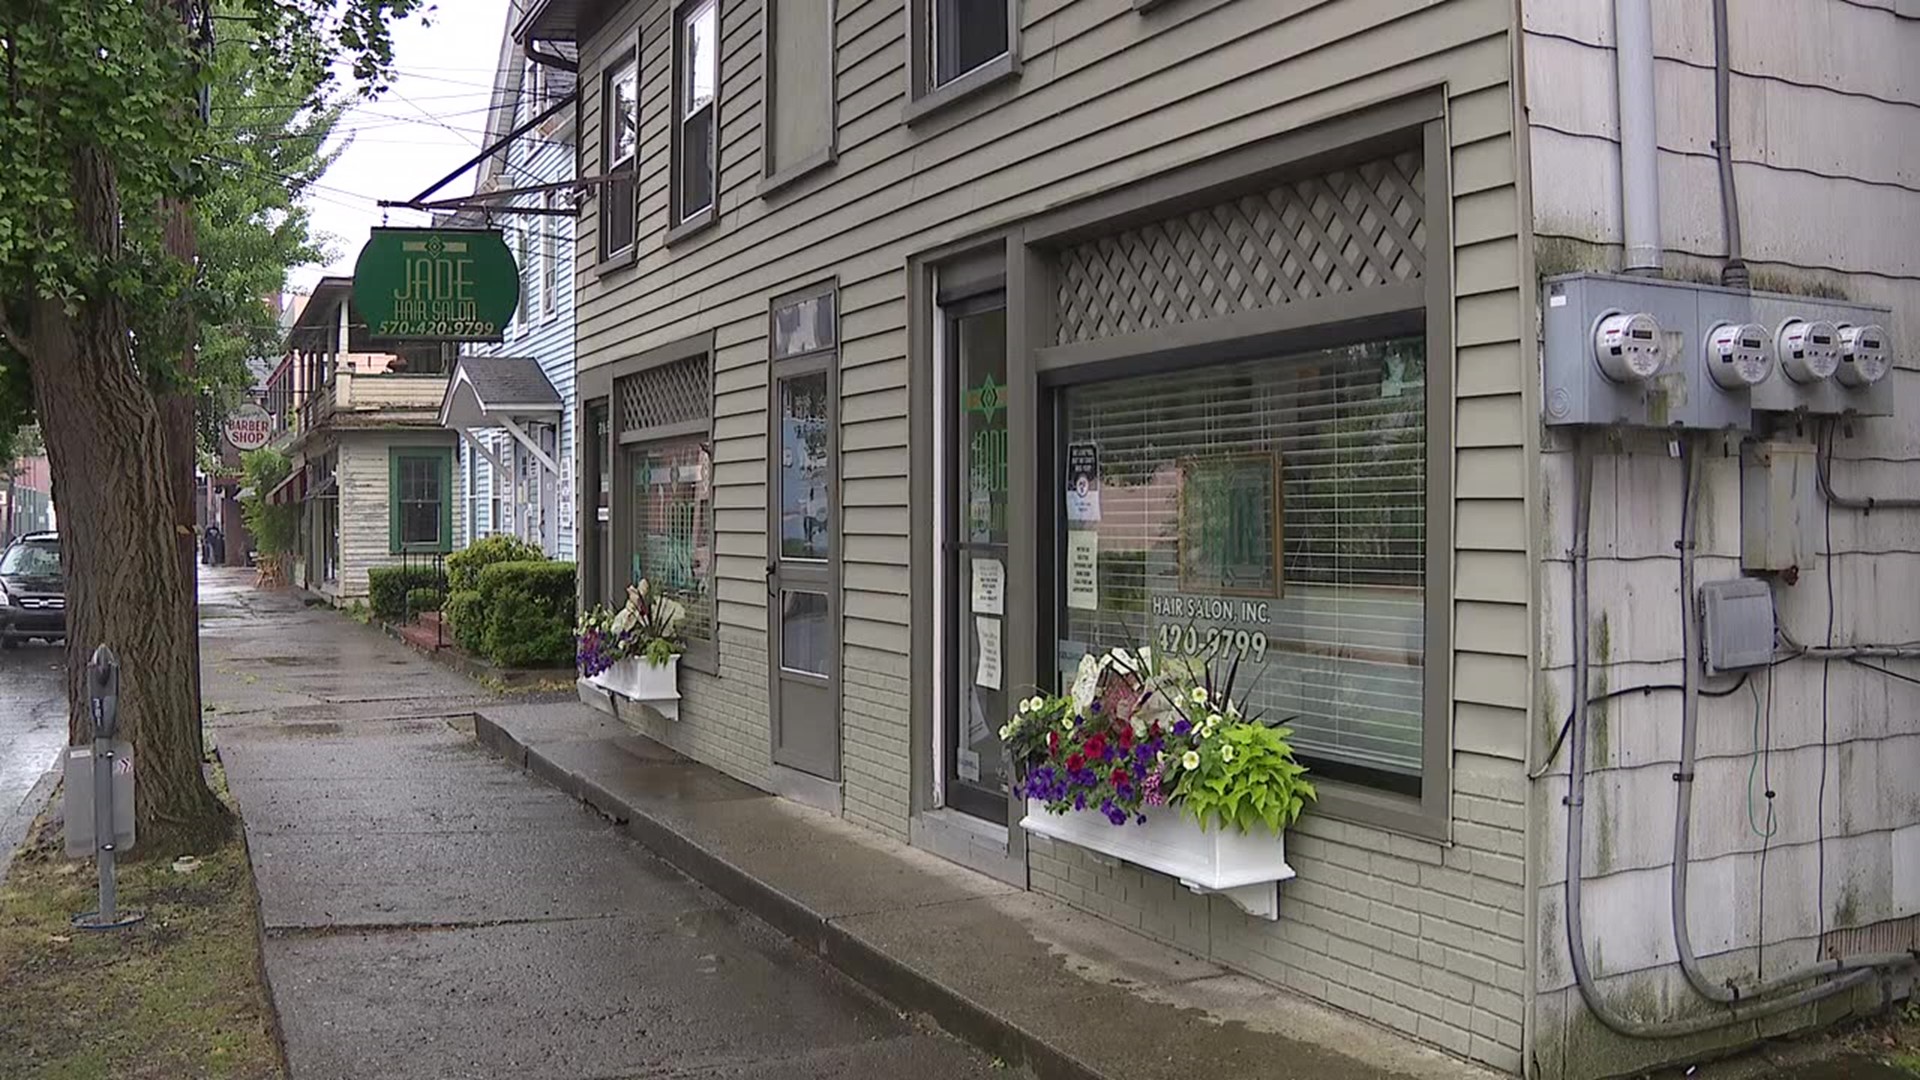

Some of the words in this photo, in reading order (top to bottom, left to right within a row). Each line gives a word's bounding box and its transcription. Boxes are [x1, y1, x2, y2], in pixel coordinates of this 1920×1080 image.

[394, 258, 474, 300] JADE
[394, 300, 428, 321] HAIR
[431, 301, 476, 321] SALON
[228, 419, 269, 432] BARBER
[232, 431, 264, 443] SHOP
[1152, 596, 1184, 616] HAIR
[1242, 602, 1271, 623] INC.
[1158, 622, 1268, 664] 420-9799
